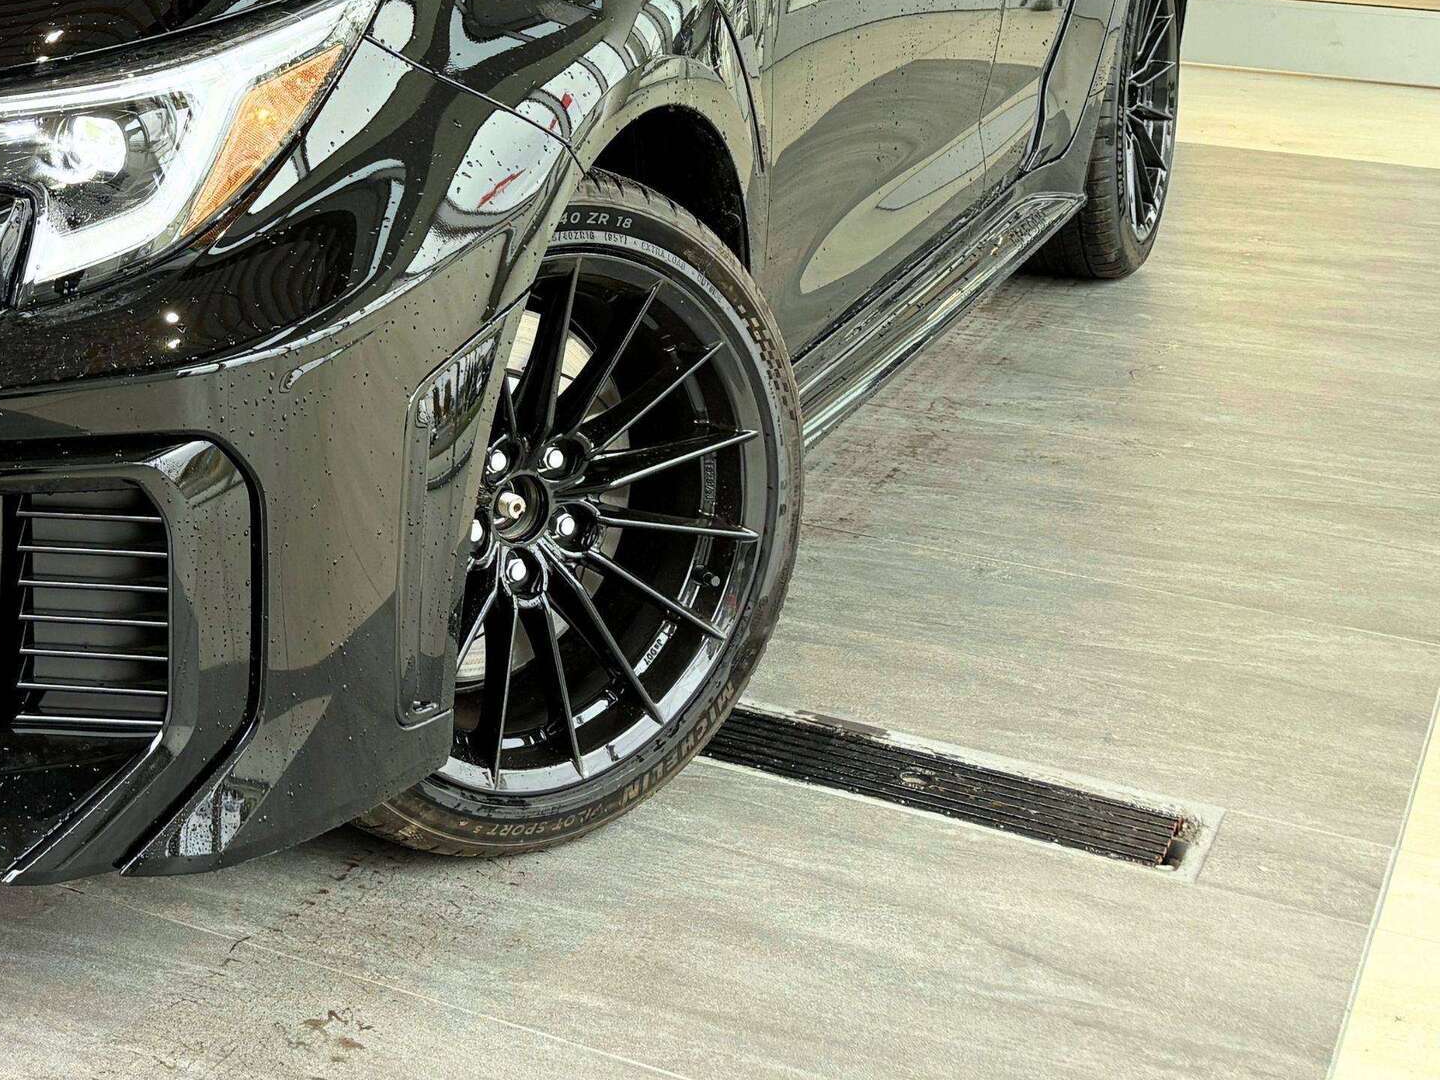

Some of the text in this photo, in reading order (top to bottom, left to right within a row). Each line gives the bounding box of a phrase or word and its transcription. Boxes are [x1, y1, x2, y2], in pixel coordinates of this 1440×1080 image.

[587, 212, 609, 225] ZR
[617, 216, 633, 229] 18
[619, 678, 736, 810] MICHELIN
[486, 821, 547, 837] SPORT
